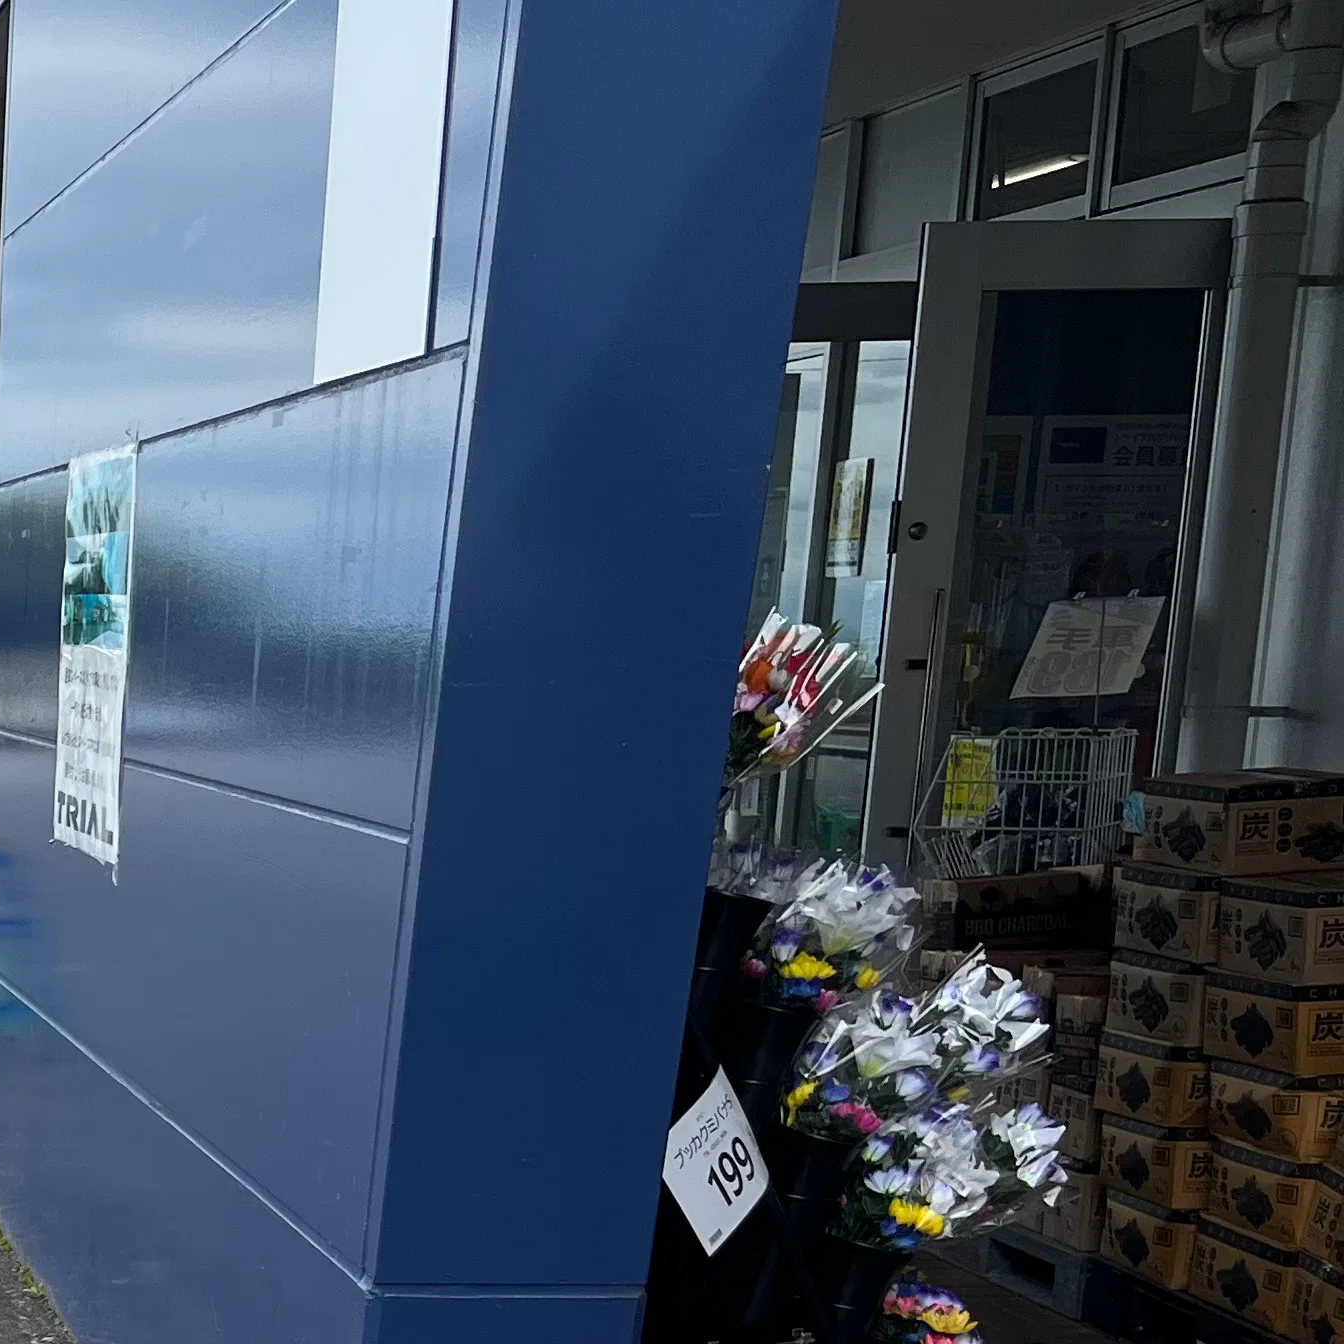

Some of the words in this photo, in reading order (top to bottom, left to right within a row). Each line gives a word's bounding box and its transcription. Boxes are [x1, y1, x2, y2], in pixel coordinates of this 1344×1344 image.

[57, 790, 114, 845] TRIAL
[1239, 812, 1270, 840] 炭
[1319, 919, 1344, 948] 炭
[1312, 1011, 1344, 1041] 炭
[708, 1136, 755, 1207] 199
